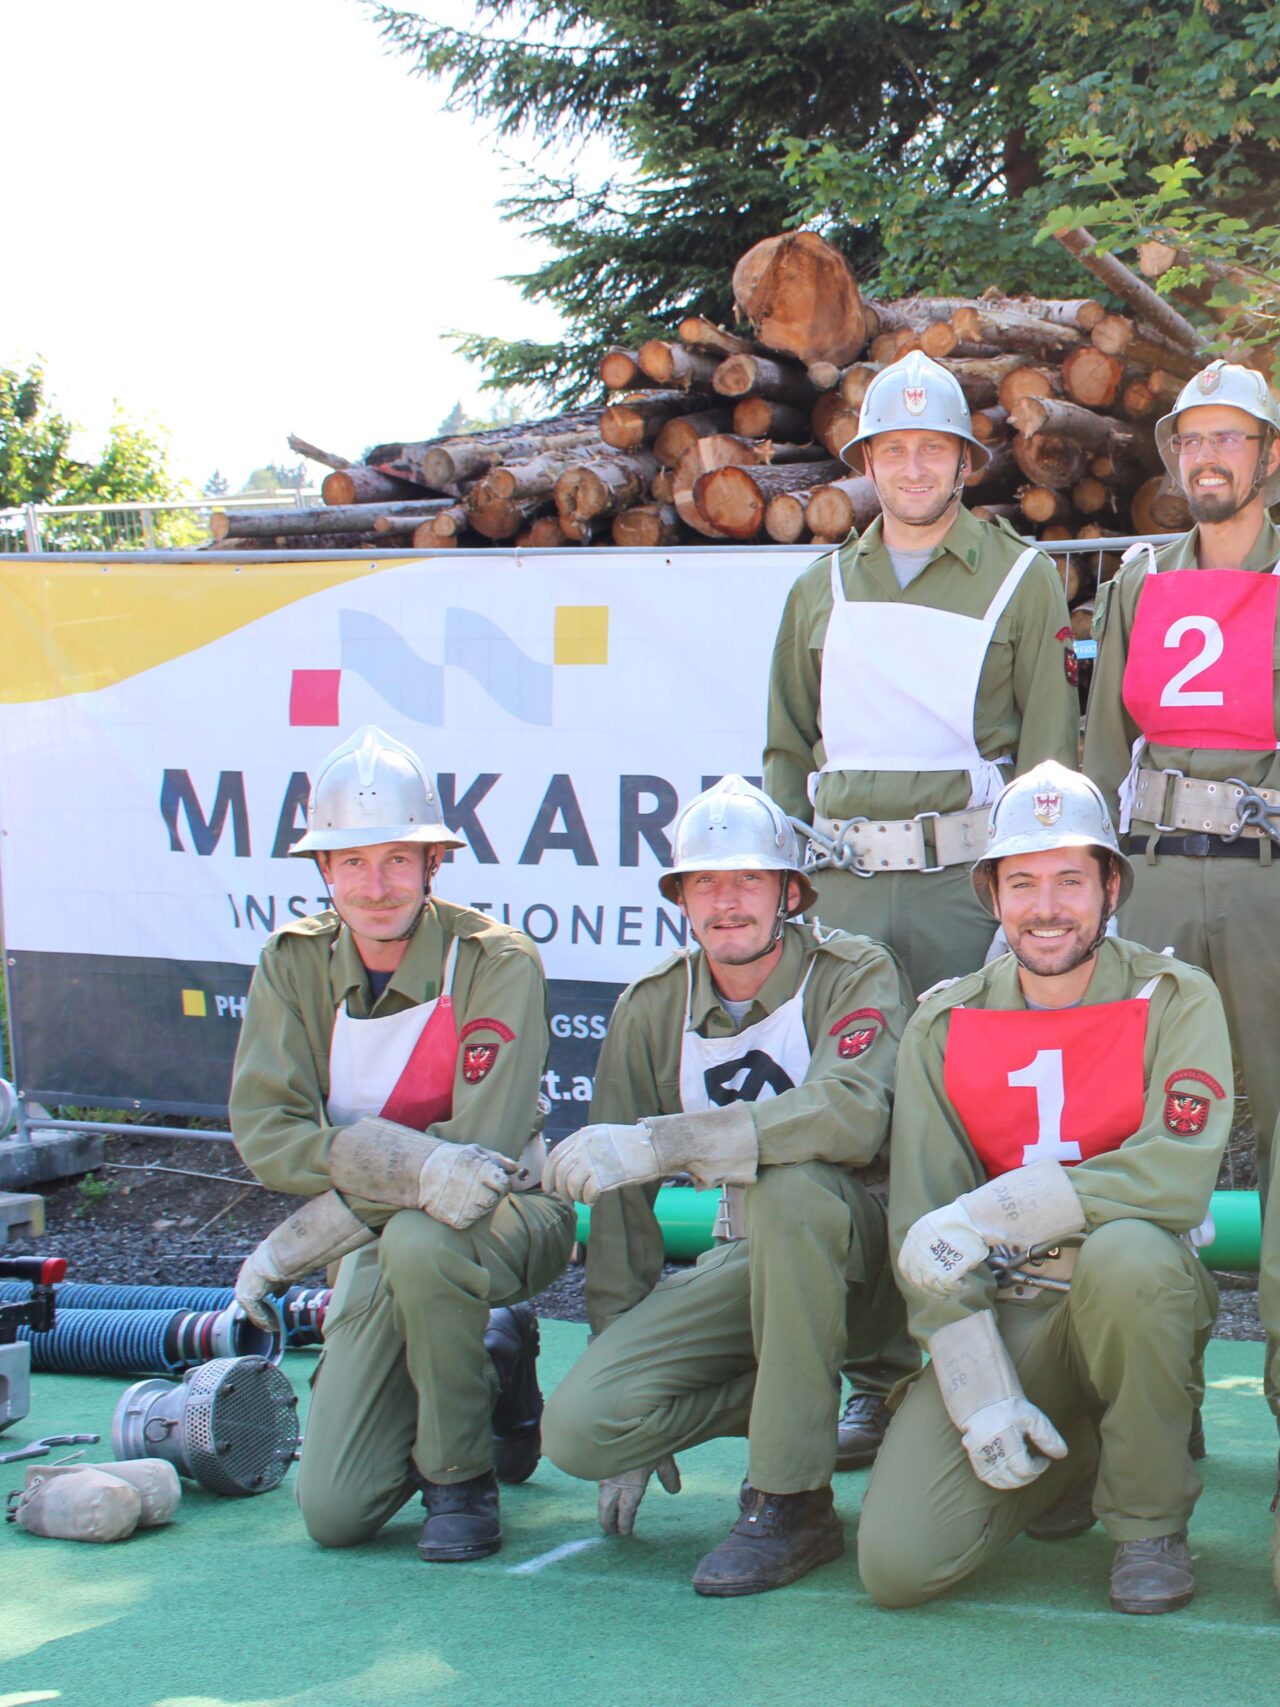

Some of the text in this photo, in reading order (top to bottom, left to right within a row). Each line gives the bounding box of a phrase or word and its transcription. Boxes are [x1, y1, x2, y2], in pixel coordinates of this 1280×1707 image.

[1160, 615, 1224, 707] 2
[160, 768, 763, 868] MAKAR
[540, 1069, 596, 1102] t.a
[1007, 1049, 1082, 1166] 1
